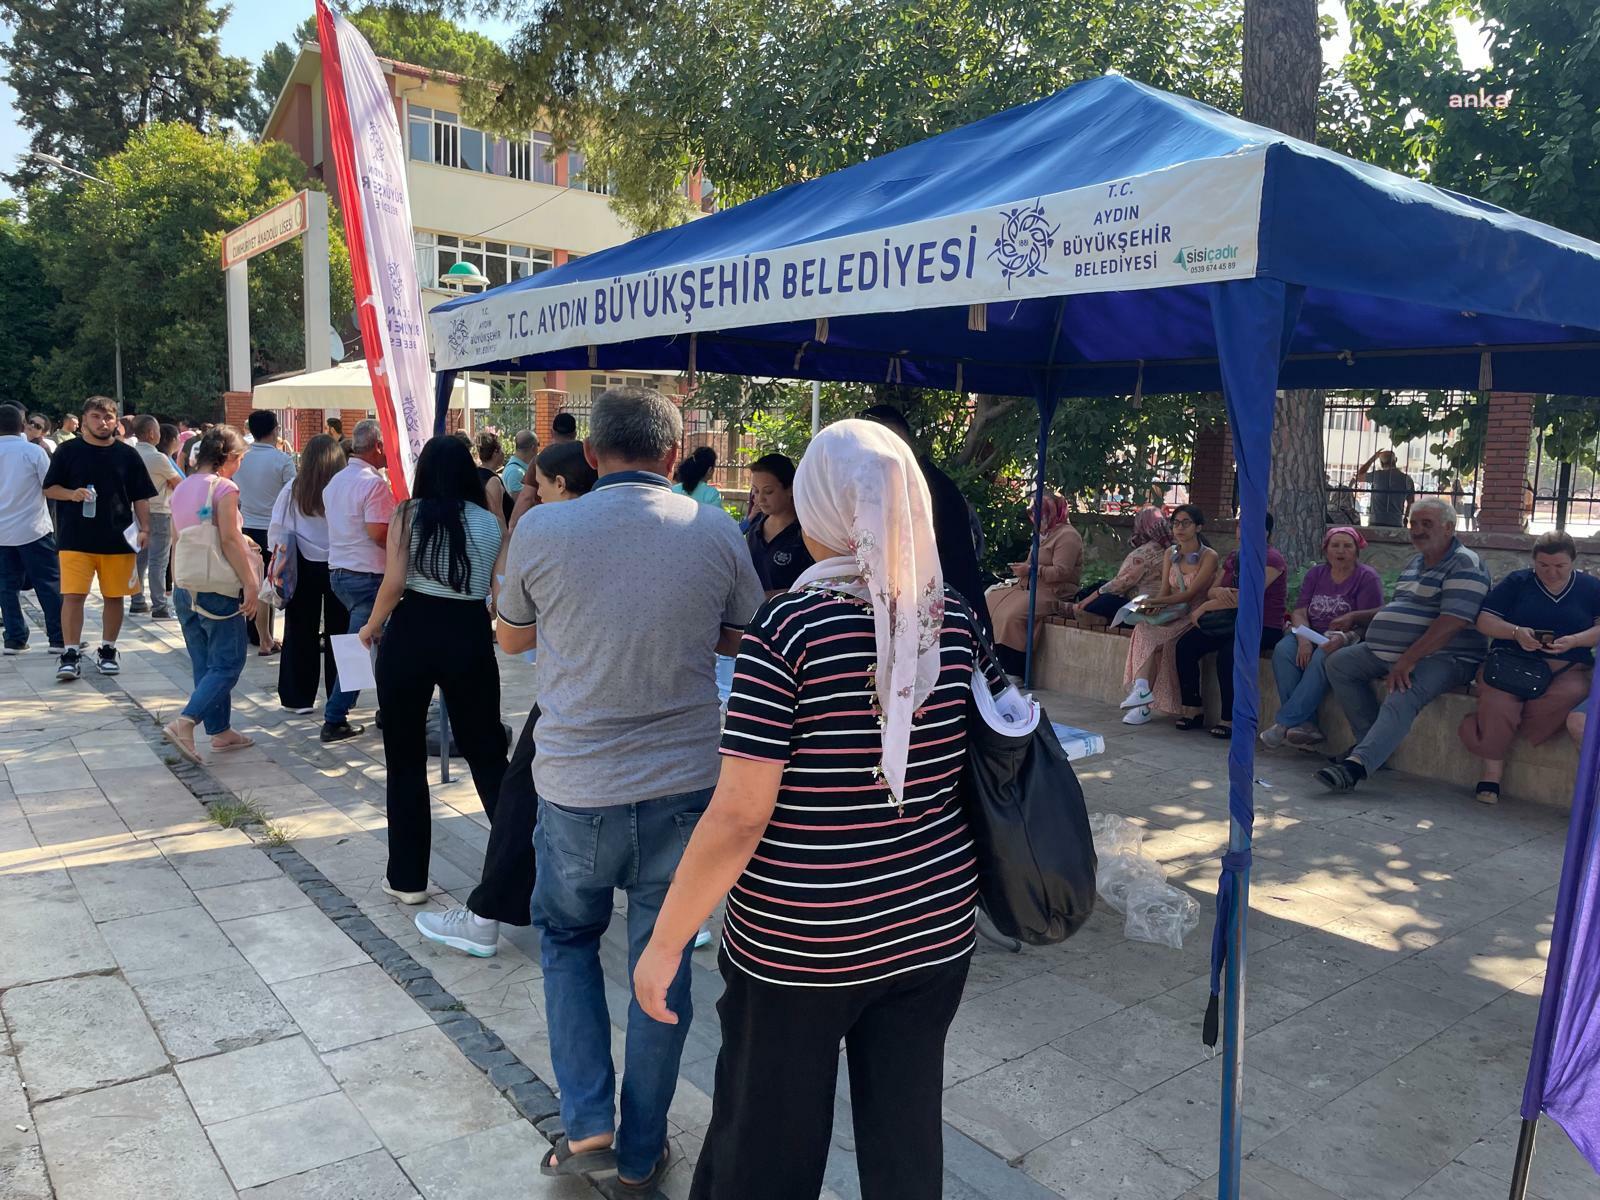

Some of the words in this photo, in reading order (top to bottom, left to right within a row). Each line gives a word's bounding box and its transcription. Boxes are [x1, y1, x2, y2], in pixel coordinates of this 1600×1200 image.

[1108, 182, 1134, 198] T.C.
[1093, 205, 1139, 226] AYDIN
[1063, 223, 1172, 257] BÜYÜKŞEHİR
[1075, 251, 1157, 278] BELEDİYESİ
[1190, 265, 1205, 274] 0539
[1218, 262, 1227, 270] 45
[508, 310, 534, 340] T.C.
[538, 296, 588, 335] AYDIN
[594, 254, 771, 325] BÜYÜKŞEHİR
[782, 225, 978, 300] BELEDİYESİ
